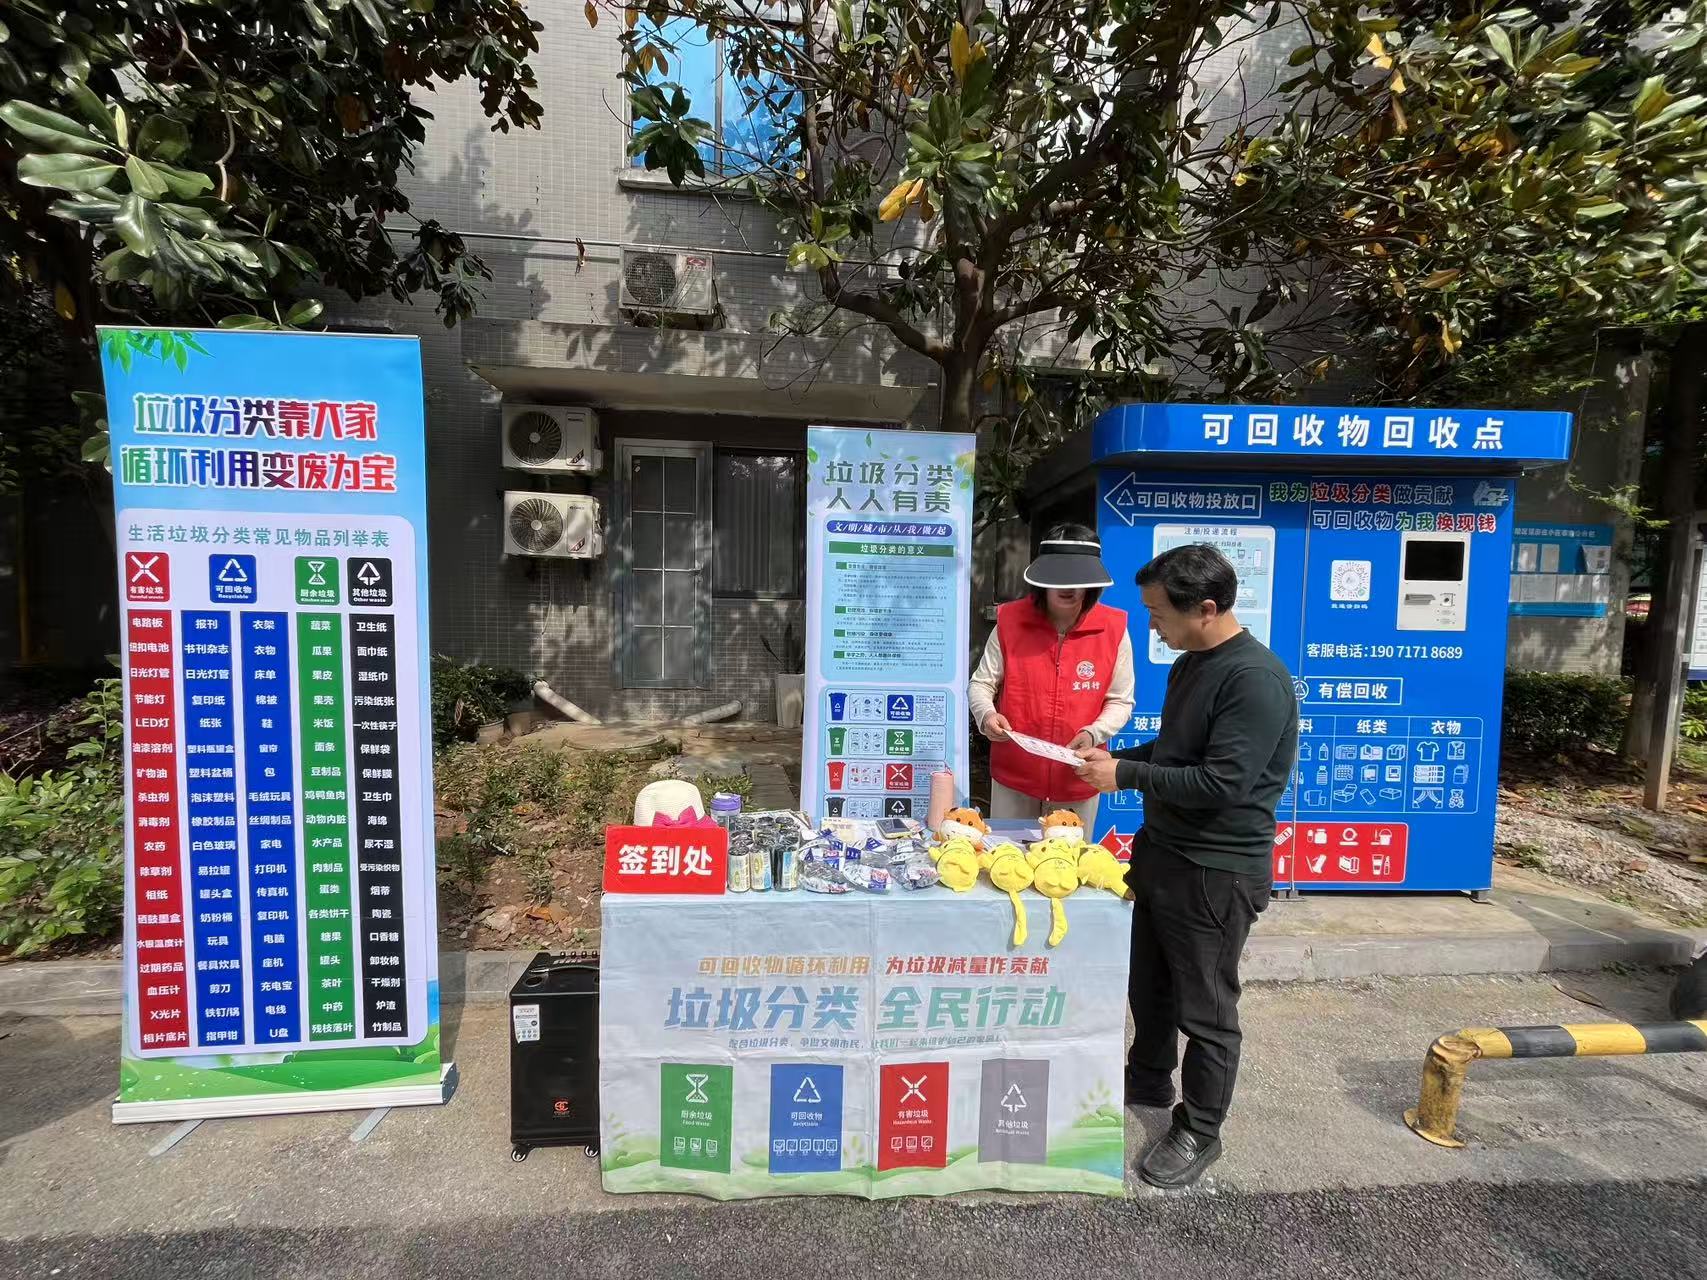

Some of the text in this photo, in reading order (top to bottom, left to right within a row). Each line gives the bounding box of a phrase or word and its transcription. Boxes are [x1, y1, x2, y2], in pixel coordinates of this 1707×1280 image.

[134, 394, 377, 440] 垃圾分类靠大家
[1201, 413, 1505, 450] 可回收物回收点
[121, 445, 397, 493] 循环利用变废为宝
[826, 461, 953, 488] 垃圾分类
[1269, 482, 1454, 505] 我为垃圾分类做贡献
[826, 487, 951, 513] 人人有责
[1136, 491, 1256, 510] 可回收物投放口
[1312, 509, 1497, 533] 可回收物为我换现钱
[128, 523, 390, 548] 生活垃圾分类常见物品列举表
[860, 544, 924, 555] 垃圾分类的意义
[130, 586, 164, 594] 有害垃圾
[216, 585, 252, 594] 可回收物
[300, 589, 335, 598] 厨余垃圾
[352, 588, 387, 598] 其他垃圾
[132, 617, 164, 628] 电路板
[195, 619, 218, 630] 报刊
[252, 619, 275, 630] 衣架
[310, 620, 331, 631] 蔬菜
[356, 621, 388, 633] 卫生纸
[184, 643, 229, 654] 书刊杂志
[254, 645, 276, 656] 衣物
[312, 646, 333, 656] 瓜果
[356, 646, 388, 657] 面巾纸
[1398, 645, 1427, 659] 7171
[1430, 646, 1463, 660] 8689
[130, 667, 170, 679] 日光灯管
[185, 669, 229, 680] 日光灯管
[254, 669, 277, 680] 床单
[312, 670, 333, 681] 果皮
[358, 671, 389, 682] 湿纸巾
[1319, 682, 1388, 699] 有偿回收
[134, 693, 166, 705] 节能灯
[191, 695, 226, 706] 复印纸
[255, 694, 278, 705] 棉被
[353, 695, 395, 707] 污染纸张
[135, 717, 170, 728] LED灯
[199, 718, 222, 728] 纸张
[261, 718, 273, 729] 鞋
[313, 718, 334, 728] 米饭
[354, 720, 397, 731] 一次性筷子
[1356, 719, 1388, 734] 纸类
[1430, 720, 1461, 735] 衣物
[132, 742, 173, 754] 油漆溶剂
[314, 741, 335, 752] 面条
[360, 743, 391, 755] 保鲜袋
[136, 768, 168, 779] 矿物油
[188, 767, 233, 778] 塑料盆桶
[264, 767, 276, 777] 包
[311, 766, 342, 777] 豆制品
[361, 768, 393, 779] 保鲜膜
[137, 792, 170, 803] 杀虫剂
[190, 792, 235, 803] 泡沫塑料
[248, 791, 292, 802] 毛绒玩具
[304, 790, 346, 800] 鸡鸭鱼肉
[362, 791, 393, 802] 卫生巾
[138, 816, 171, 827] 消毒剂
[191, 816, 236, 827] 橡胶制品
[305, 814, 347, 825] 动物内脏
[367, 815, 388, 826] 海绵
[143, 841, 166, 852] 农药
[192, 840, 236, 851] 白色玻璃
[260, 839, 282, 849] 家电
[311, 837, 343, 848] 水产品
[364, 838, 395, 849] 尿不湿
[618, 844, 713, 876] 签到处
[139, 866, 173, 877] 除草剂
[198, 865, 231, 876] 易拉罐
[254, 863, 287, 875] 打印机
[312, 862, 344, 873] 肉制品
[145, 889, 169, 900] 相纸
[199, 888, 233, 899] 罐头盒
[256, 886, 289, 897] 传真机
[319, 884, 340, 894] 蛋类
[200, 912, 233, 923] 奶粉桶
[257, 910, 289, 921] 复印机
[307, 908, 350, 919] 各类饼干
[371, 908, 392, 919] 陶瓷
[207, 935, 229, 946] 玩具
[263, 933, 285, 944] 电脑
[320, 931, 342, 942] 糖果
[369, 931, 400, 942] 口香糖
[197, 959, 241, 971] 餐具炊具
[319, 955, 341, 965] 罐头
[369, 955, 400, 966] 卸妆棉
[139, 962, 184, 974] 过期药品
[699, 956, 1050, 976] 可回收物循环利用 为垃圾减量作贡献
[261, 980, 293, 992] 充电宝
[321, 977, 343, 988] 茶叶
[370, 977, 401, 988] 干燥剂
[147, 984, 181, 996] 血压计
[209, 983, 231, 994] 剪刀
[265, 1004, 287, 1015] 电线
[322, 1001, 343, 1012] 中药
[664, 985, 1067, 1031] 垃圾分类 全民行动
[150, 1008, 181, 1020] X光片
[205, 1007, 240, 1018] 铁钉/锅
[311, 1022, 354, 1034] 残枝落叶
[371, 1021, 402, 1032] 竹制品
[143, 1031, 187, 1044] 相片底片
[269, 1027, 289, 1038] U盘
[681, 1110, 712, 1120] 厨余垃圾
[791, 1111, 823, 1121] 可回收物
[897, 1109, 929, 1119] 有害垃圾
